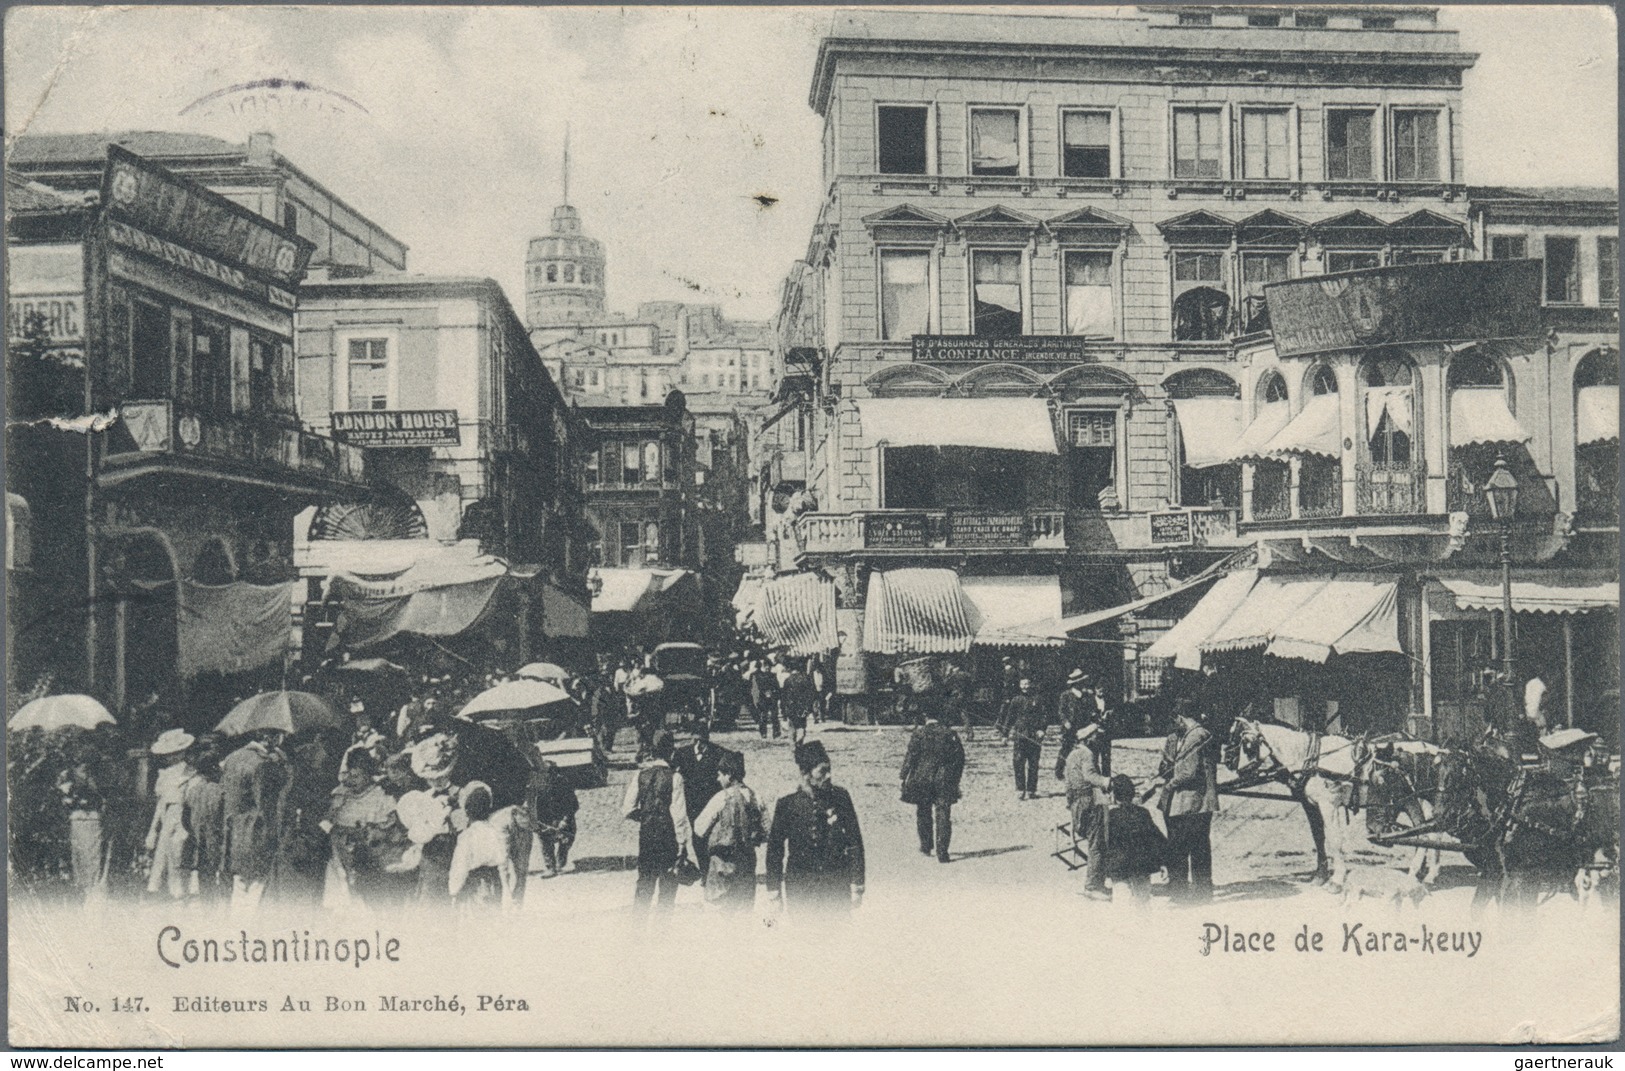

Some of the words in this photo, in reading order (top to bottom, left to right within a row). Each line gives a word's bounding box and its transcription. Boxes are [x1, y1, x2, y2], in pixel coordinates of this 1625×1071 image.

[915, 349, 934, 359] LA
[334, 415, 398, 431] LONDON
[401, 412, 456, 429] HOUSE
